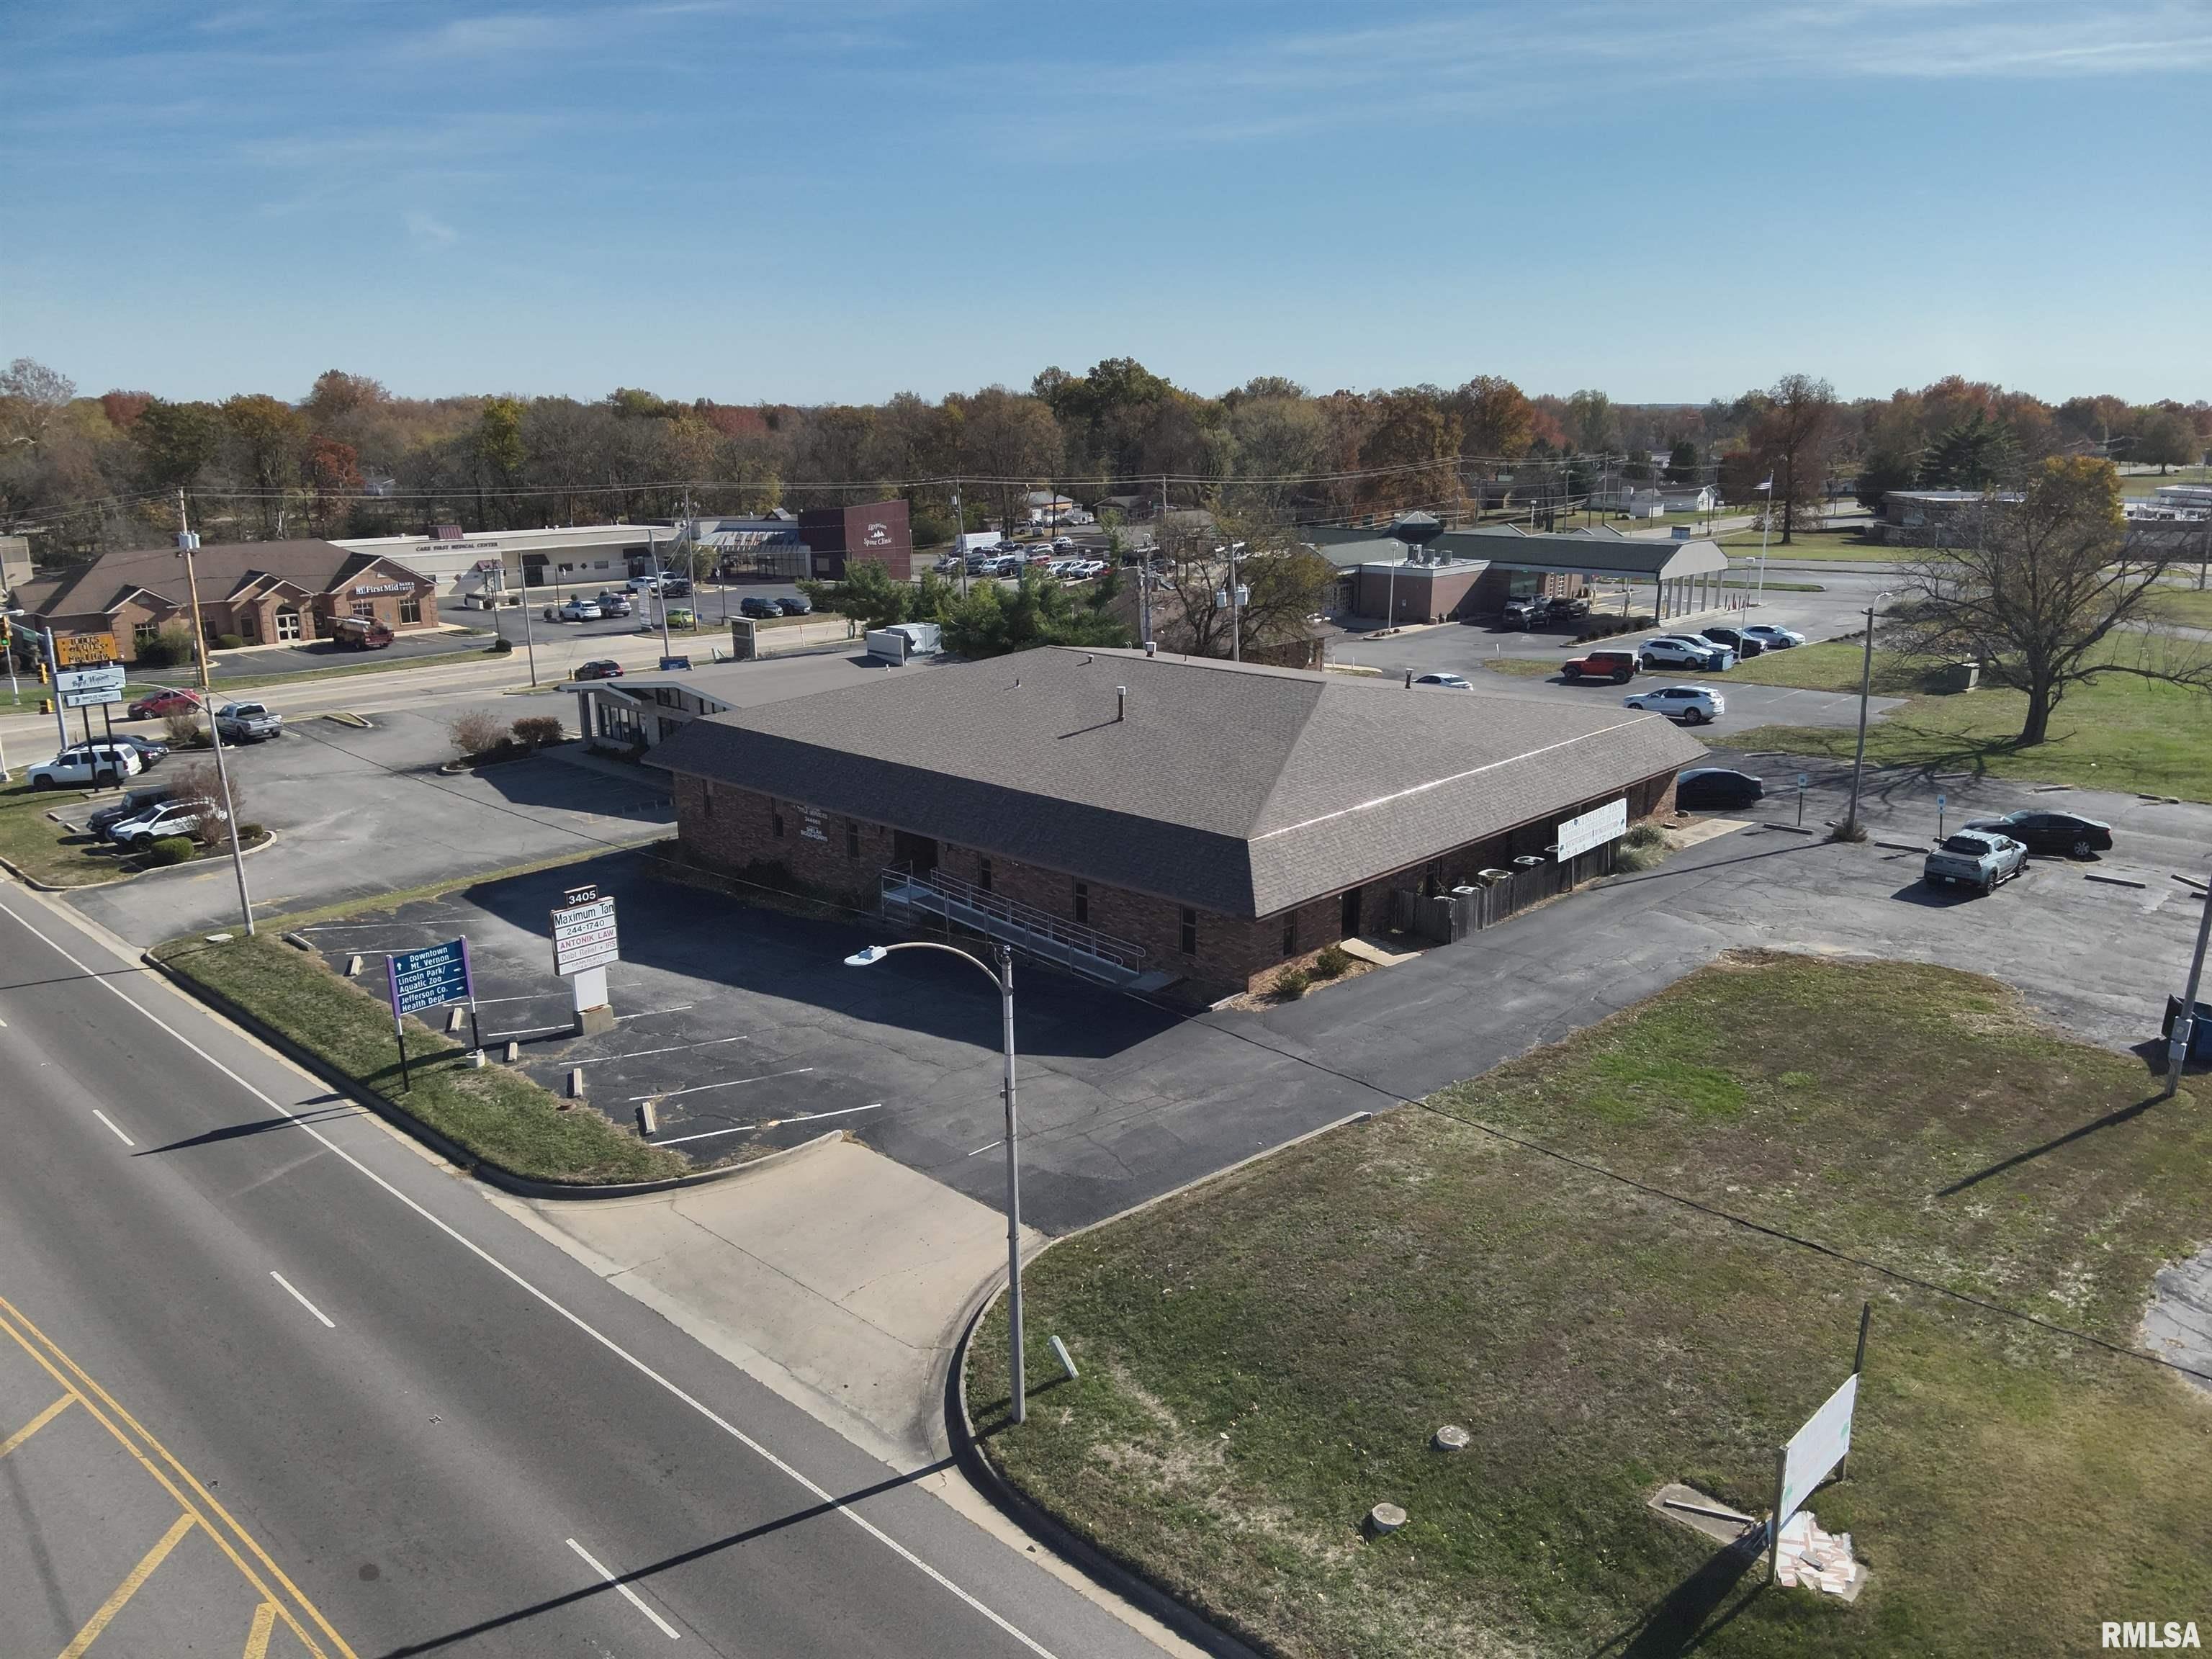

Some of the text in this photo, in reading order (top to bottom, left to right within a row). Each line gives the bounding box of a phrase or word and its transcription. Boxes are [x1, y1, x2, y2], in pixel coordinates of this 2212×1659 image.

[864, 538, 877, 547] Spine
[569, 890, 596, 904] 3405
[554, 903, 613, 927] Maximum Tan
[567, 920, 605, 935] 244-1740
[560, 930, 613, 950] ANTONIK LAW
[410, 947, 448, 962] Downtown
[562, 940, 616, 961] Debt Relief IRS
[424, 955, 449, 966] Vernon
[398, 966, 446, 985] Lincoln Park/
[400, 980, 426, 993] Aquatic
[401, 990, 434, 1004] Jefferson
[402, 994, 445, 1012] Health Dept
